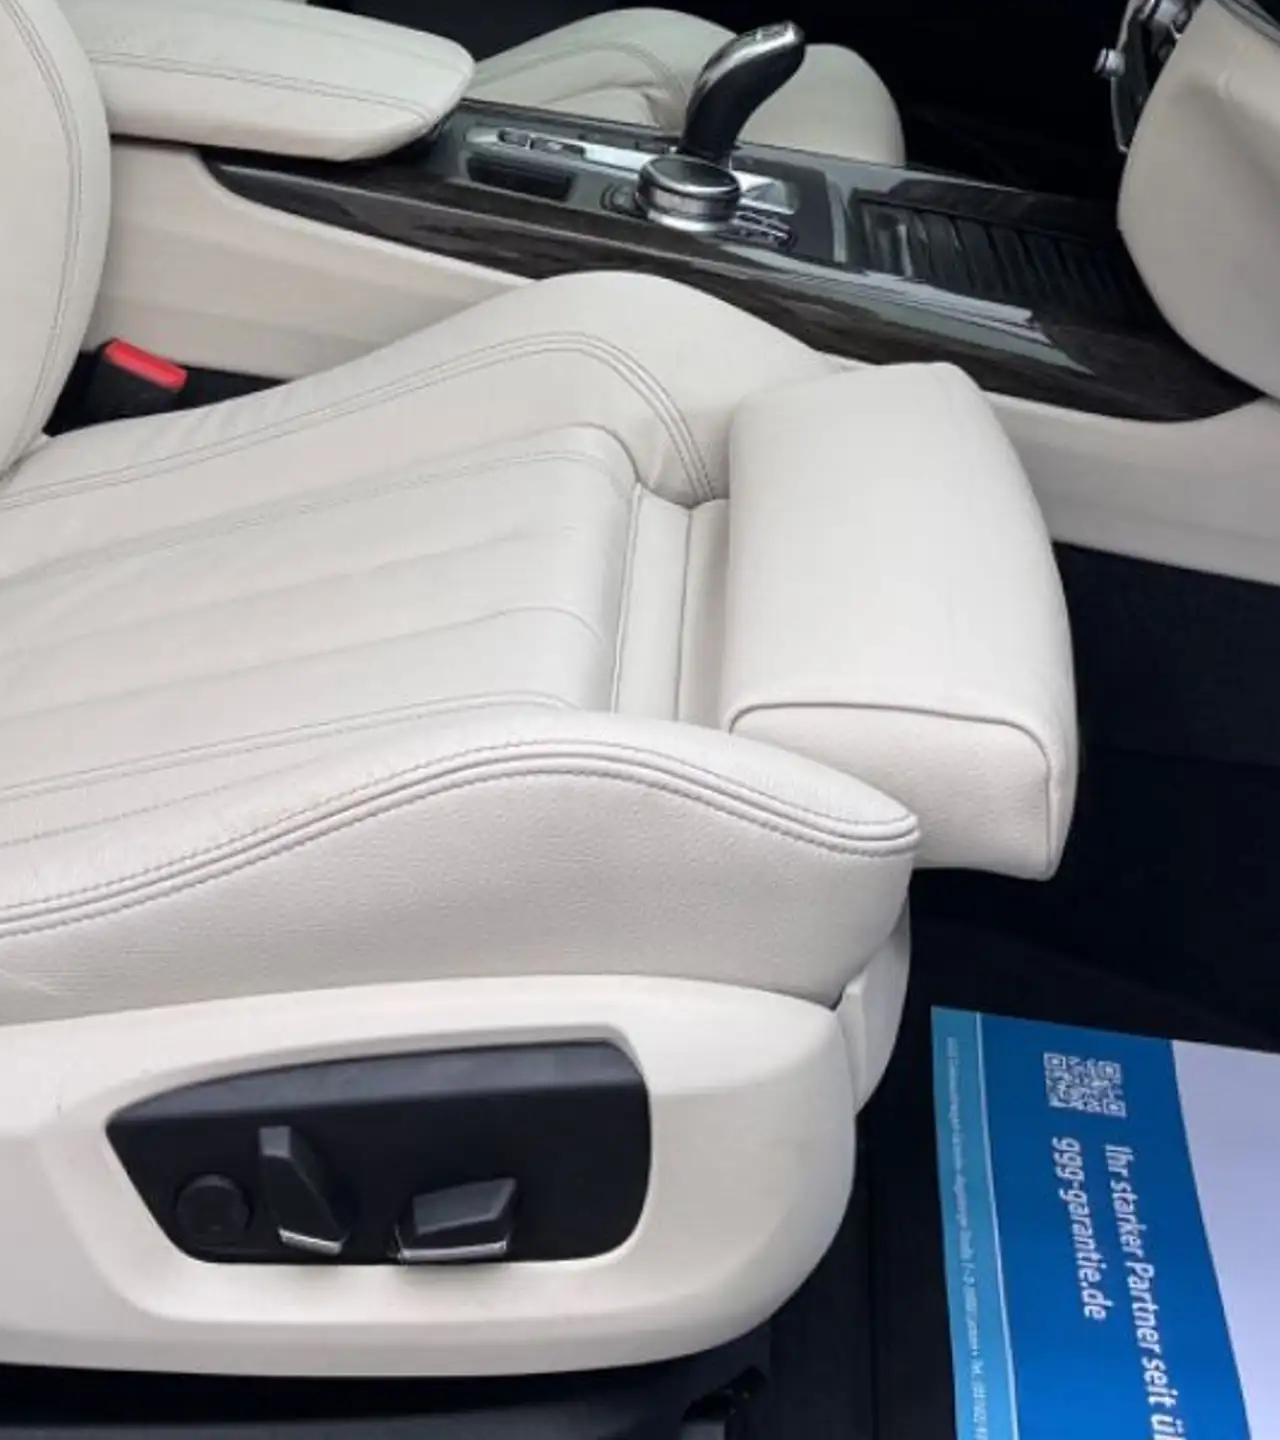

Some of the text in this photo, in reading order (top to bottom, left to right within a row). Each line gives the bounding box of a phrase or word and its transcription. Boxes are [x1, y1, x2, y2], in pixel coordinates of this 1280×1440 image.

[1106, 1143, 1134, 1178] Ihr
[1051, 1136, 1113, 1322] ggg-garantie.de
[1111, 1178, 1147, 1257] starker
[1125, 1259, 1160, 1355] Partner
[1141, 1355, 1179, 1409] seit
